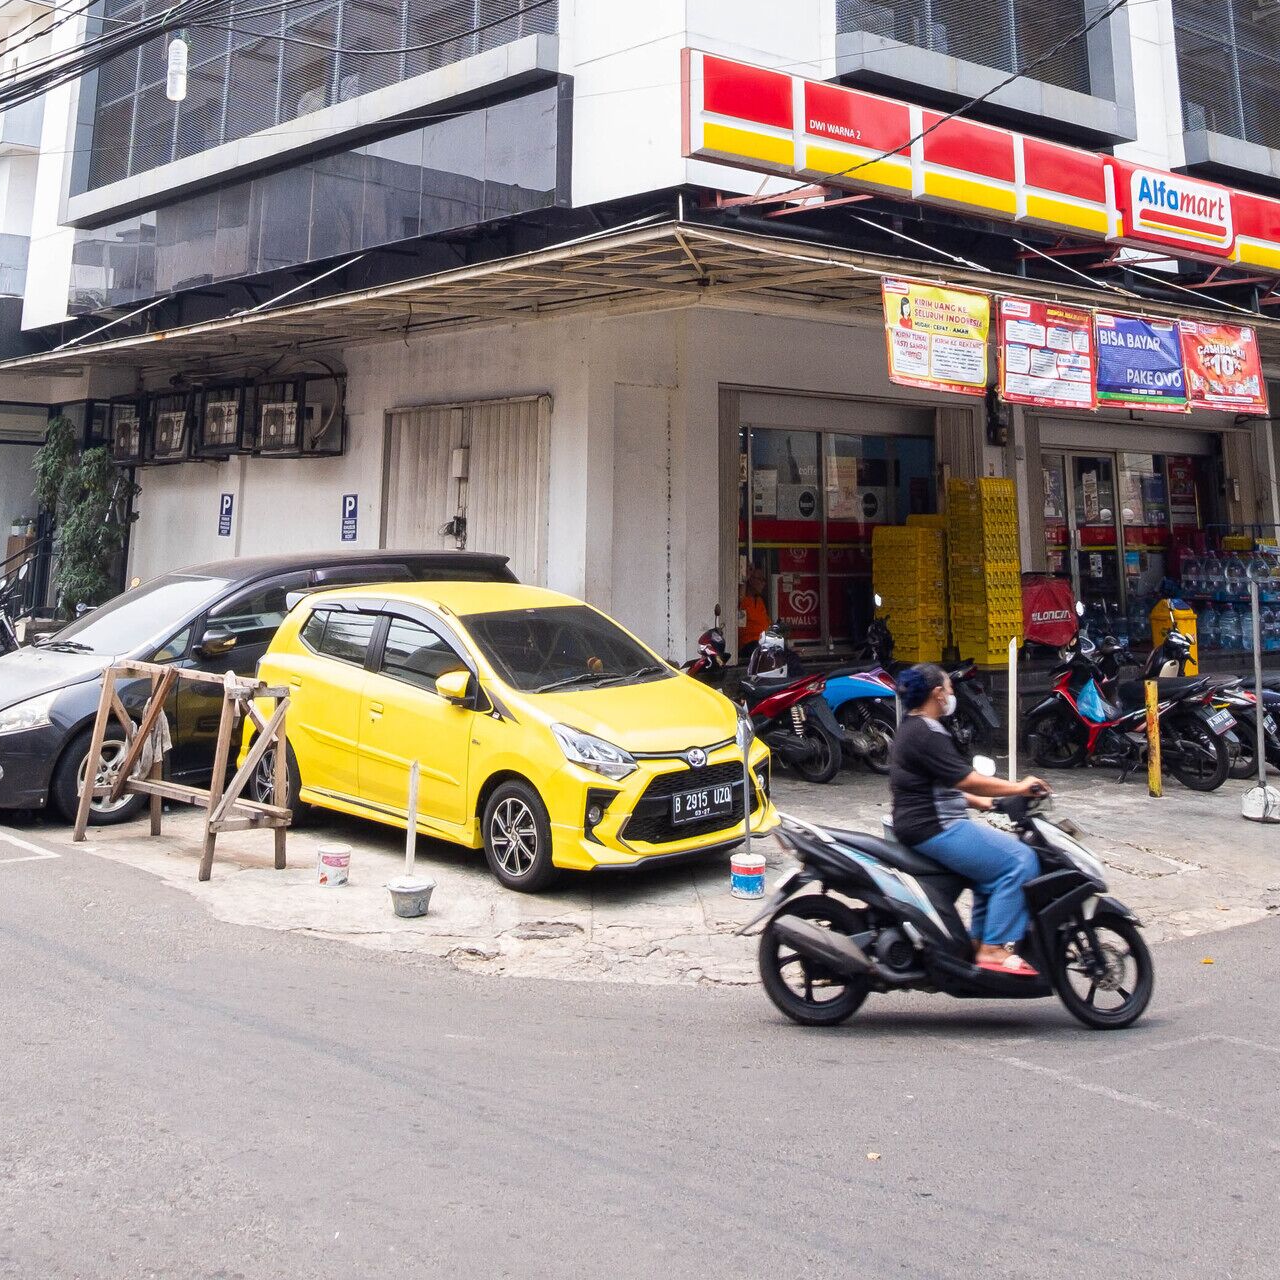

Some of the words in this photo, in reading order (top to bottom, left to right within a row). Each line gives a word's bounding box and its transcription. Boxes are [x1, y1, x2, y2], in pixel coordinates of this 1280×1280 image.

[809, 119, 826, 131] DWI
[827, 123, 856, 139] WARNA
[856, 130, 862, 140] 2
[1138, 175, 1225, 222] Alfamart
[914, 298, 933, 308] KIRIM
[934, 302, 956, 312] UANG
[914, 309, 944, 321] SELURUH
[1099, 330, 1125, 347] BISA
[1126, 333, 1161, 352] BAYAR
[1126, 368, 1154, 386] PAKE
[1154, 371, 1182, 388] OVO
[223, 495, 231, 515] P
[346, 496, 355, 518] P
[675, 797, 681, 814] B
[686, 791, 708, 811] 2915
